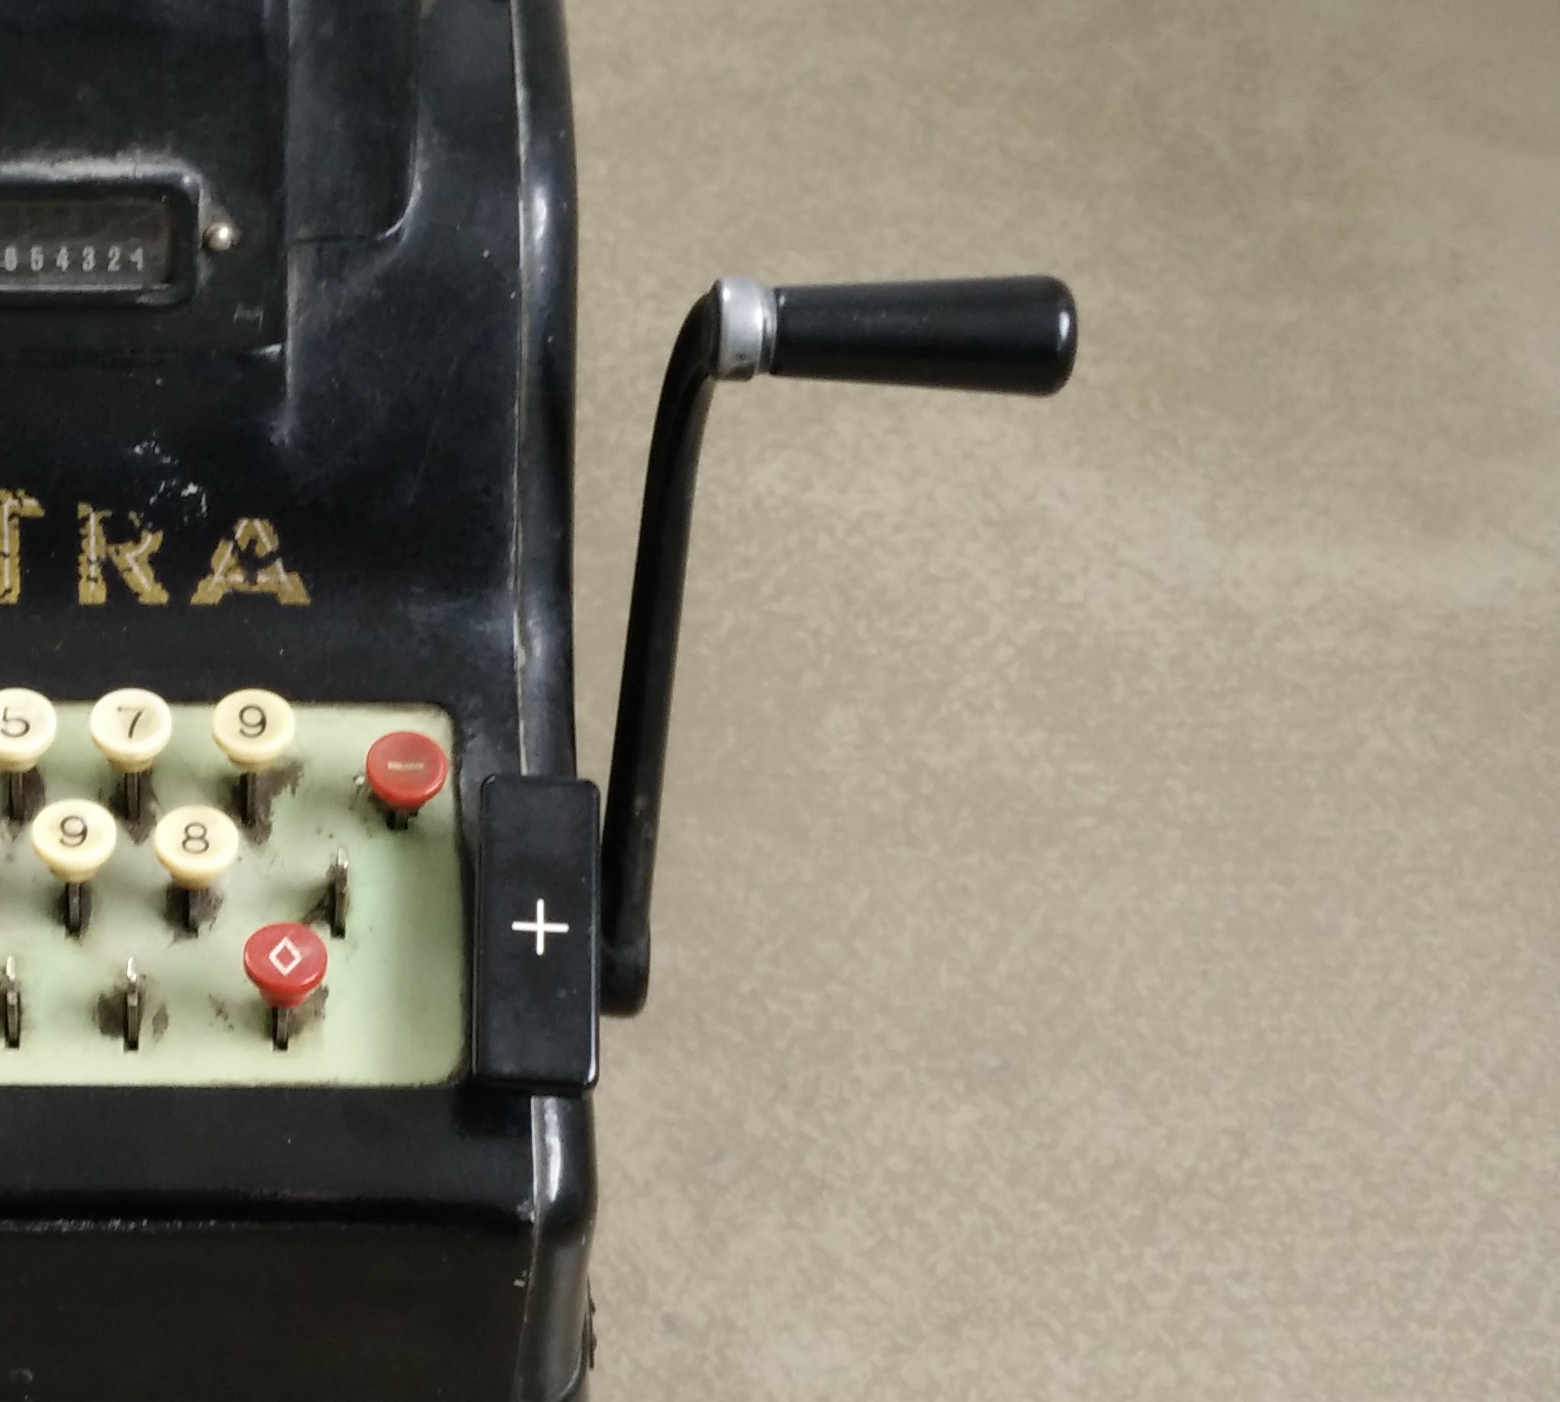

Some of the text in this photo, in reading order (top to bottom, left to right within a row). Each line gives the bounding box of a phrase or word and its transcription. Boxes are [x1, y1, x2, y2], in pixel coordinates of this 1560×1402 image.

[0, 706, 31, 739] 5
[116, 705, 146, 739] 7
[238, 704, 268, 739] 9
[180, 821, 210, 854] 8
